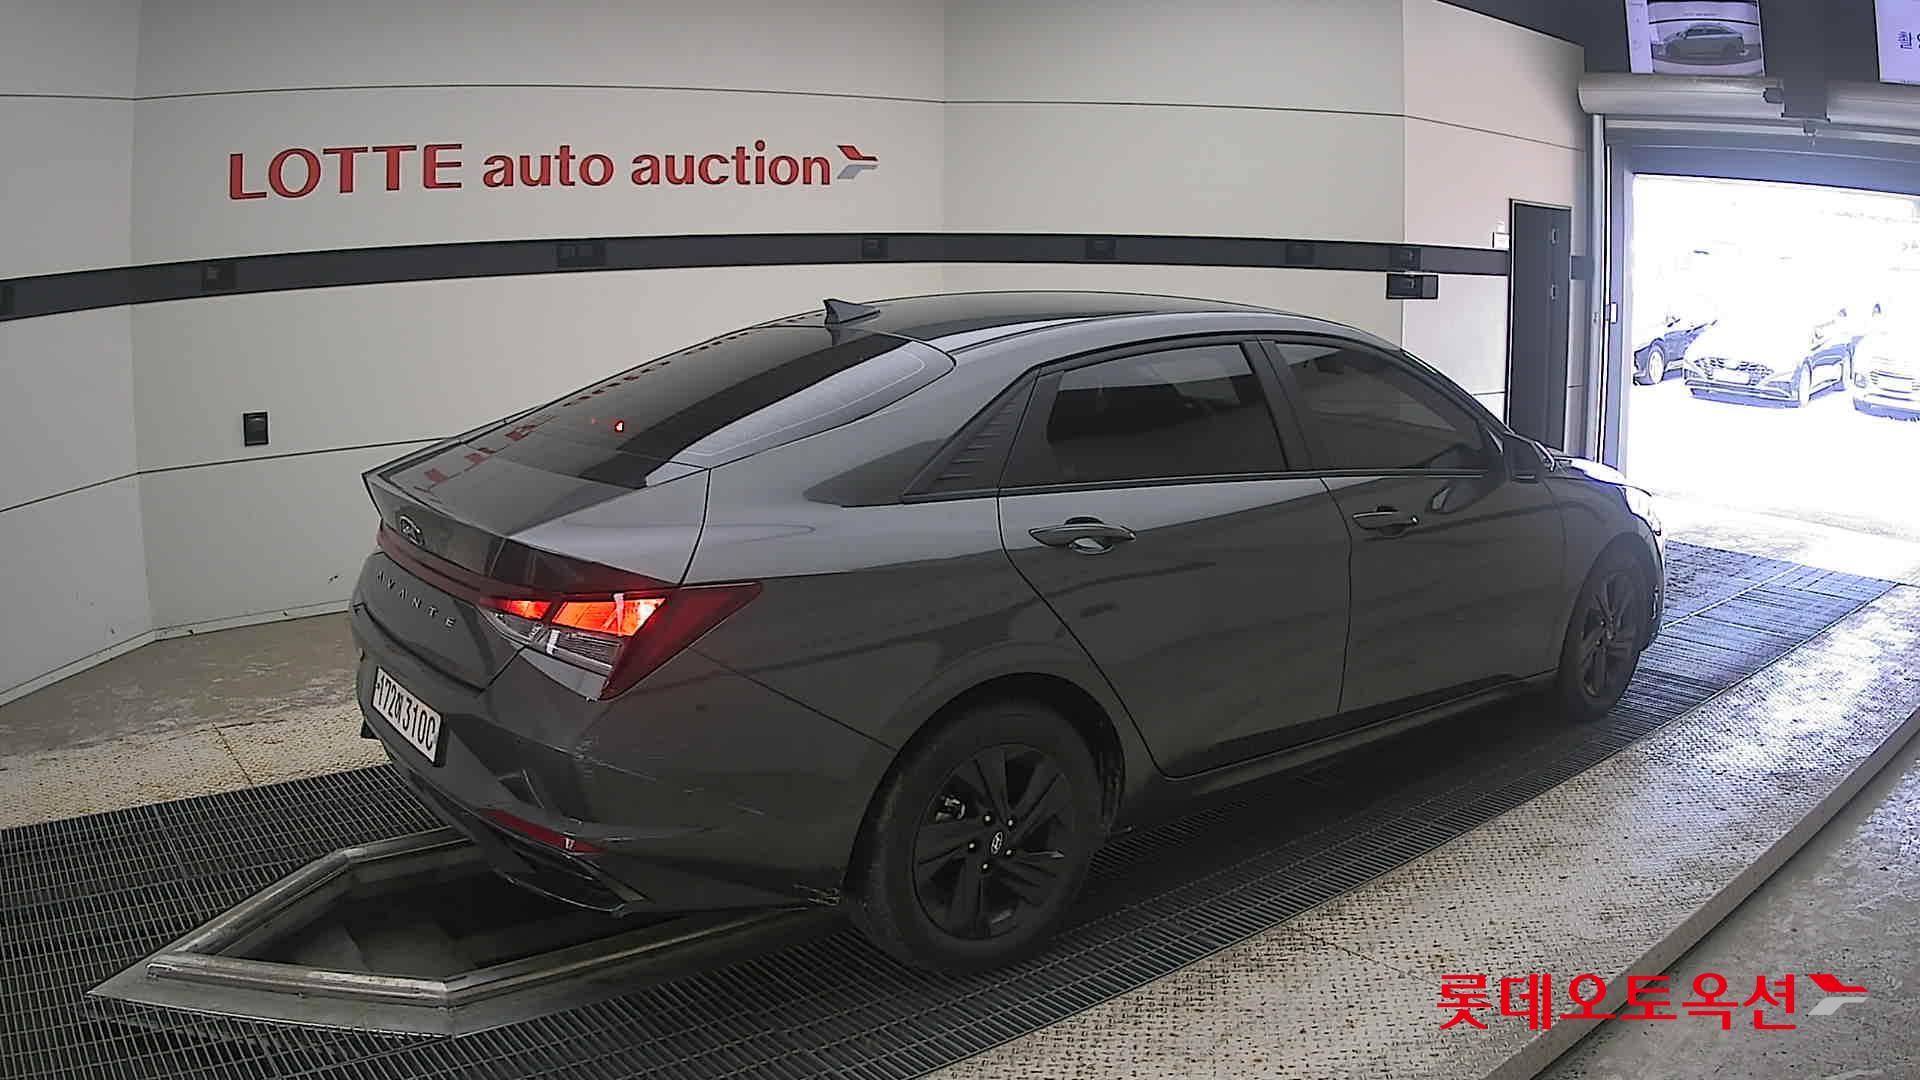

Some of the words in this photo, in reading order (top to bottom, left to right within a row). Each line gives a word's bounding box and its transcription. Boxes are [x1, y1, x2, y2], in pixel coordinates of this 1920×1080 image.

[229, 143, 463, 200] LOTTE
[483, 145, 613, 188] auto
[631, 140, 831, 187] auction
[376, 570, 456, 627] AVANTE
